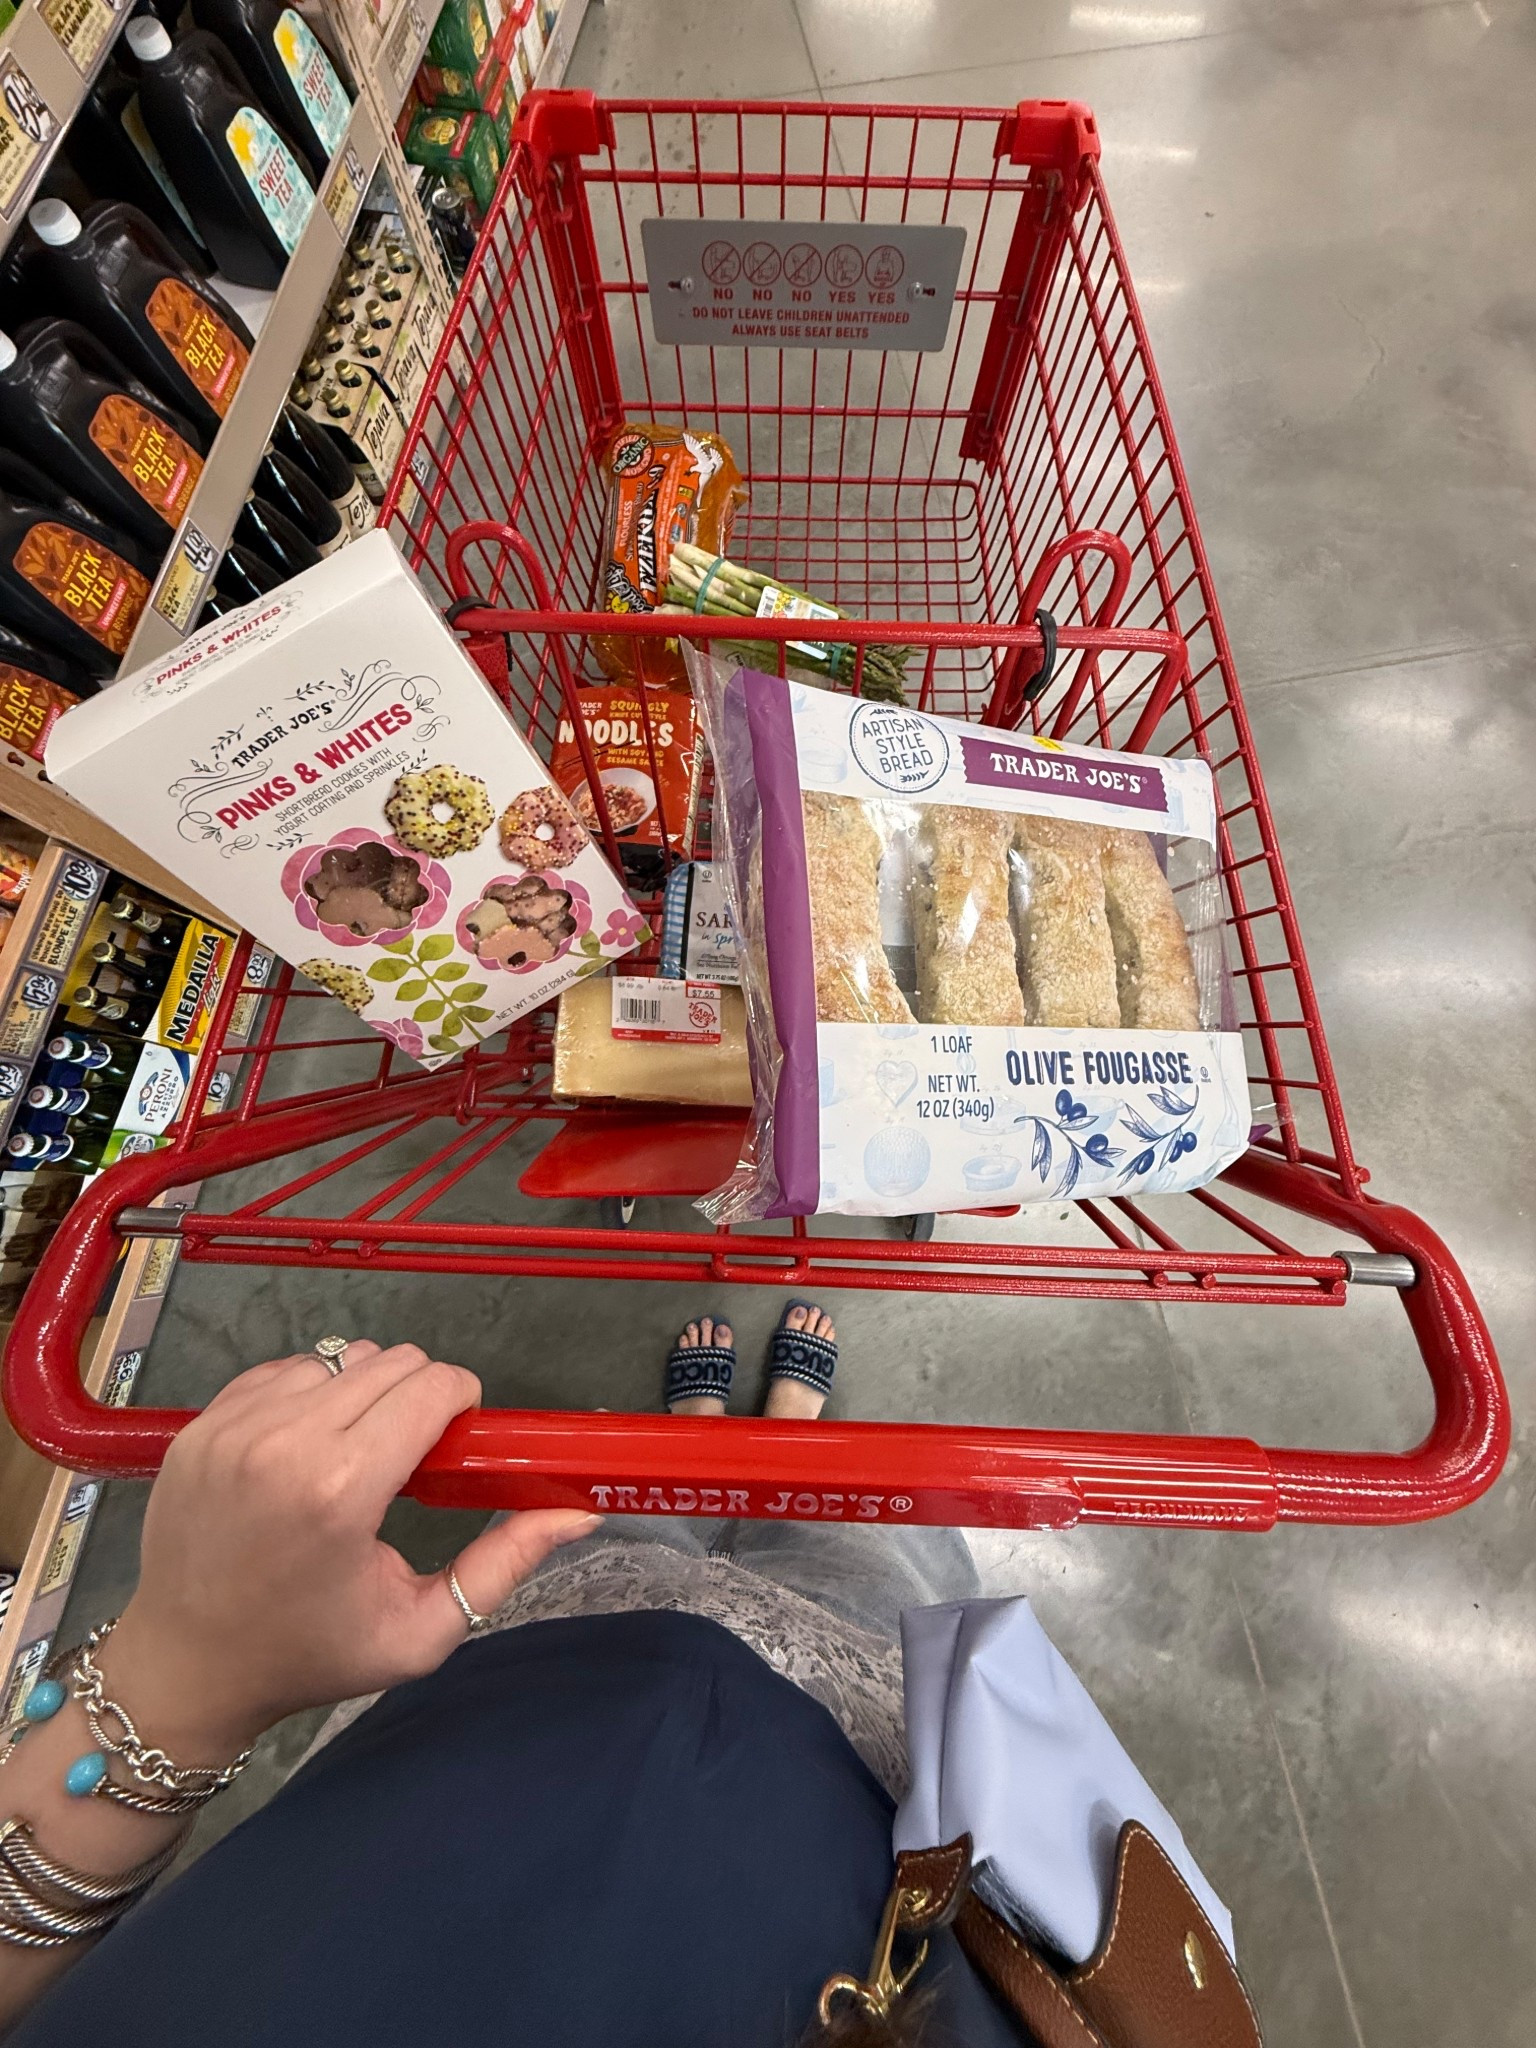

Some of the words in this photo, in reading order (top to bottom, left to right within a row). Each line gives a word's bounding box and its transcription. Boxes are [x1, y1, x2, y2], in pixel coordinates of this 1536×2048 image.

[303, 50, 326, 102] SWEET
[317, 81, 333, 113] TEA
[258, 147, 286, 198] SWEET
[274, 178, 294, 209] TEA
[713, 288, 734, 300] NO
[752, 289, 773, 301] NO
[791, 291, 812, 302] NO
[829, 291, 856, 303] YES
[868, 292, 895, 304] YES
[692, 307, 708, 319] DO
[712, 308, 734, 320] NOT
[738, 309, 773, 321] LEAVE
[776, 310, 833, 322] CHILDREN
[836, 311, 910, 325] UNATTENDED
[731, 324, 777, 337] ALWAYS
[780, 325, 801, 337] USE
[804, 326, 832, 338] SEAT
[835, 327, 869, 339] BELTS
[185, 313, 217, 369] BLACK
[203, 343, 226, 376] TEA
[361, 402, 391, 462] Tejava
[133, 426, 167, 483] BLACK
[152, 454, 177, 488] TEA
[612, 437, 650, 474] ORGANIC
[618, 500, 634, 548] FLOURLESS
[63, 548, 102, 608] BLACK
[86, 575, 114, 610] TEA
[162, 585, 180, 616] BLACK
[168, 601, 181, 619] TEA
[155, 651, 204, 686] PINKS
[206, 643, 221, 656] &
[221, 605, 282, 645] WHITES
[0, 679, 32, 740] BLACK
[17, 704, 46, 740] TEA
[231, 723, 289, 770] TRADER
[289, 701, 334, 731] JOE'S
[862, 718, 925, 739] ARTISAN
[875, 732, 926, 755] STYLE
[215, 775, 297, 831] PINKS
[293, 762, 323, 785] &
[313, 703, 414, 771] WHITES
[607, 748, 629, 756] WITH
[629, 748, 646, 757] SOY
[879, 749, 934, 774] BREAD
[274, 783, 334, 823] SHORTBREAD
[330, 761, 370, 789] COOKIES
[365, 746, 393, 767] WITH
[989, 752, 1081, 784] TRADER
[1085, 769, 1142, 795] JOE'S
[273, 811, 310, 837] YOGURT
[307, 789, 347, 817] COATING
[343, 772, 366, 796] AND
[363, 750, 411, 785] SPRINKLES
[58, 896, 73, 918] LIGHT
[48, 928, 70, 966] BLONDE
[63, 906, 79, 928] ALE
[164, 932, 221, 1044] MEDALLA
[495, 1006, 515, 1022] NET
[513, 998, 528, 1011] WT
[528, 992, 539, 1002] 10
[537, 985, 551, 997] OZ
[692, 989, 715, 998] $7.55
[688, 1002, 718, 1024] TRADER
[689, 1011, 711, 1026] JOE'S
[930, 1035, 938, 1053] 1
[941, 1035, 973, 1054] LOAF
[927, 1074, 953, 1093] NET
[955, 1074, 981, 1093] WT.
[1005, 1049, 1075, 1086] OLIVE
[1083, 1050, 1194, 1084] FOUGASSE
[143, 1068, 173, 1123] PERONI
[160, 1075, 179, 1119] AZZURRO
[916, 1099, 931, 1118] 12
[933, 1099, 950, 1118] OZ
[952, 1096, 995, 1122] (340g)
[589, 1483, 751, 1513] TRADER
[764, 1489, 886, 1517] JOE'S
